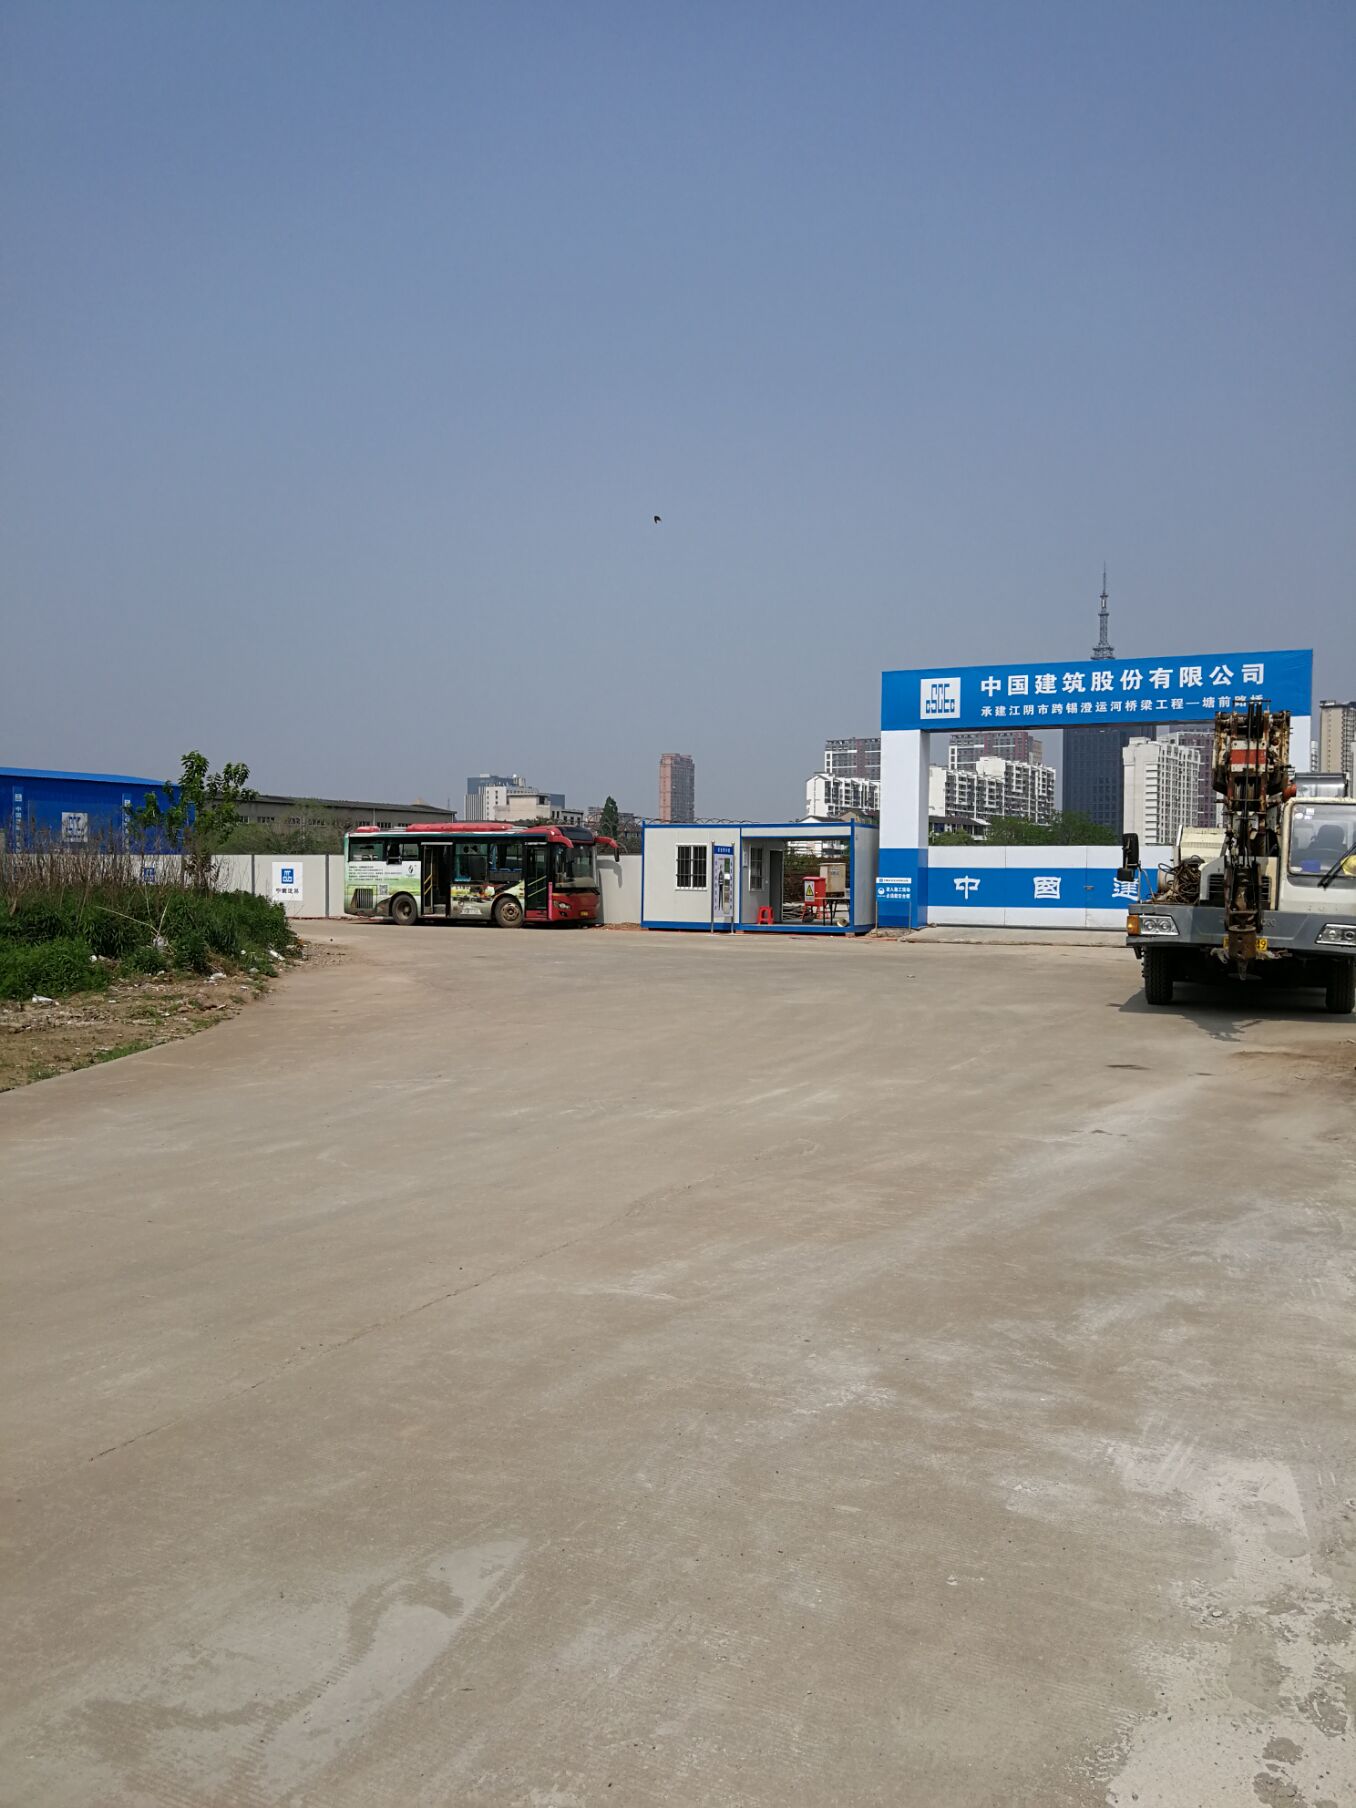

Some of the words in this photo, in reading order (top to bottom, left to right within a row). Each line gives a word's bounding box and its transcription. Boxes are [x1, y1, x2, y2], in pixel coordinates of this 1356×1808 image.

[980, 663, 1265, 697] 中国建筑股份有限公司
